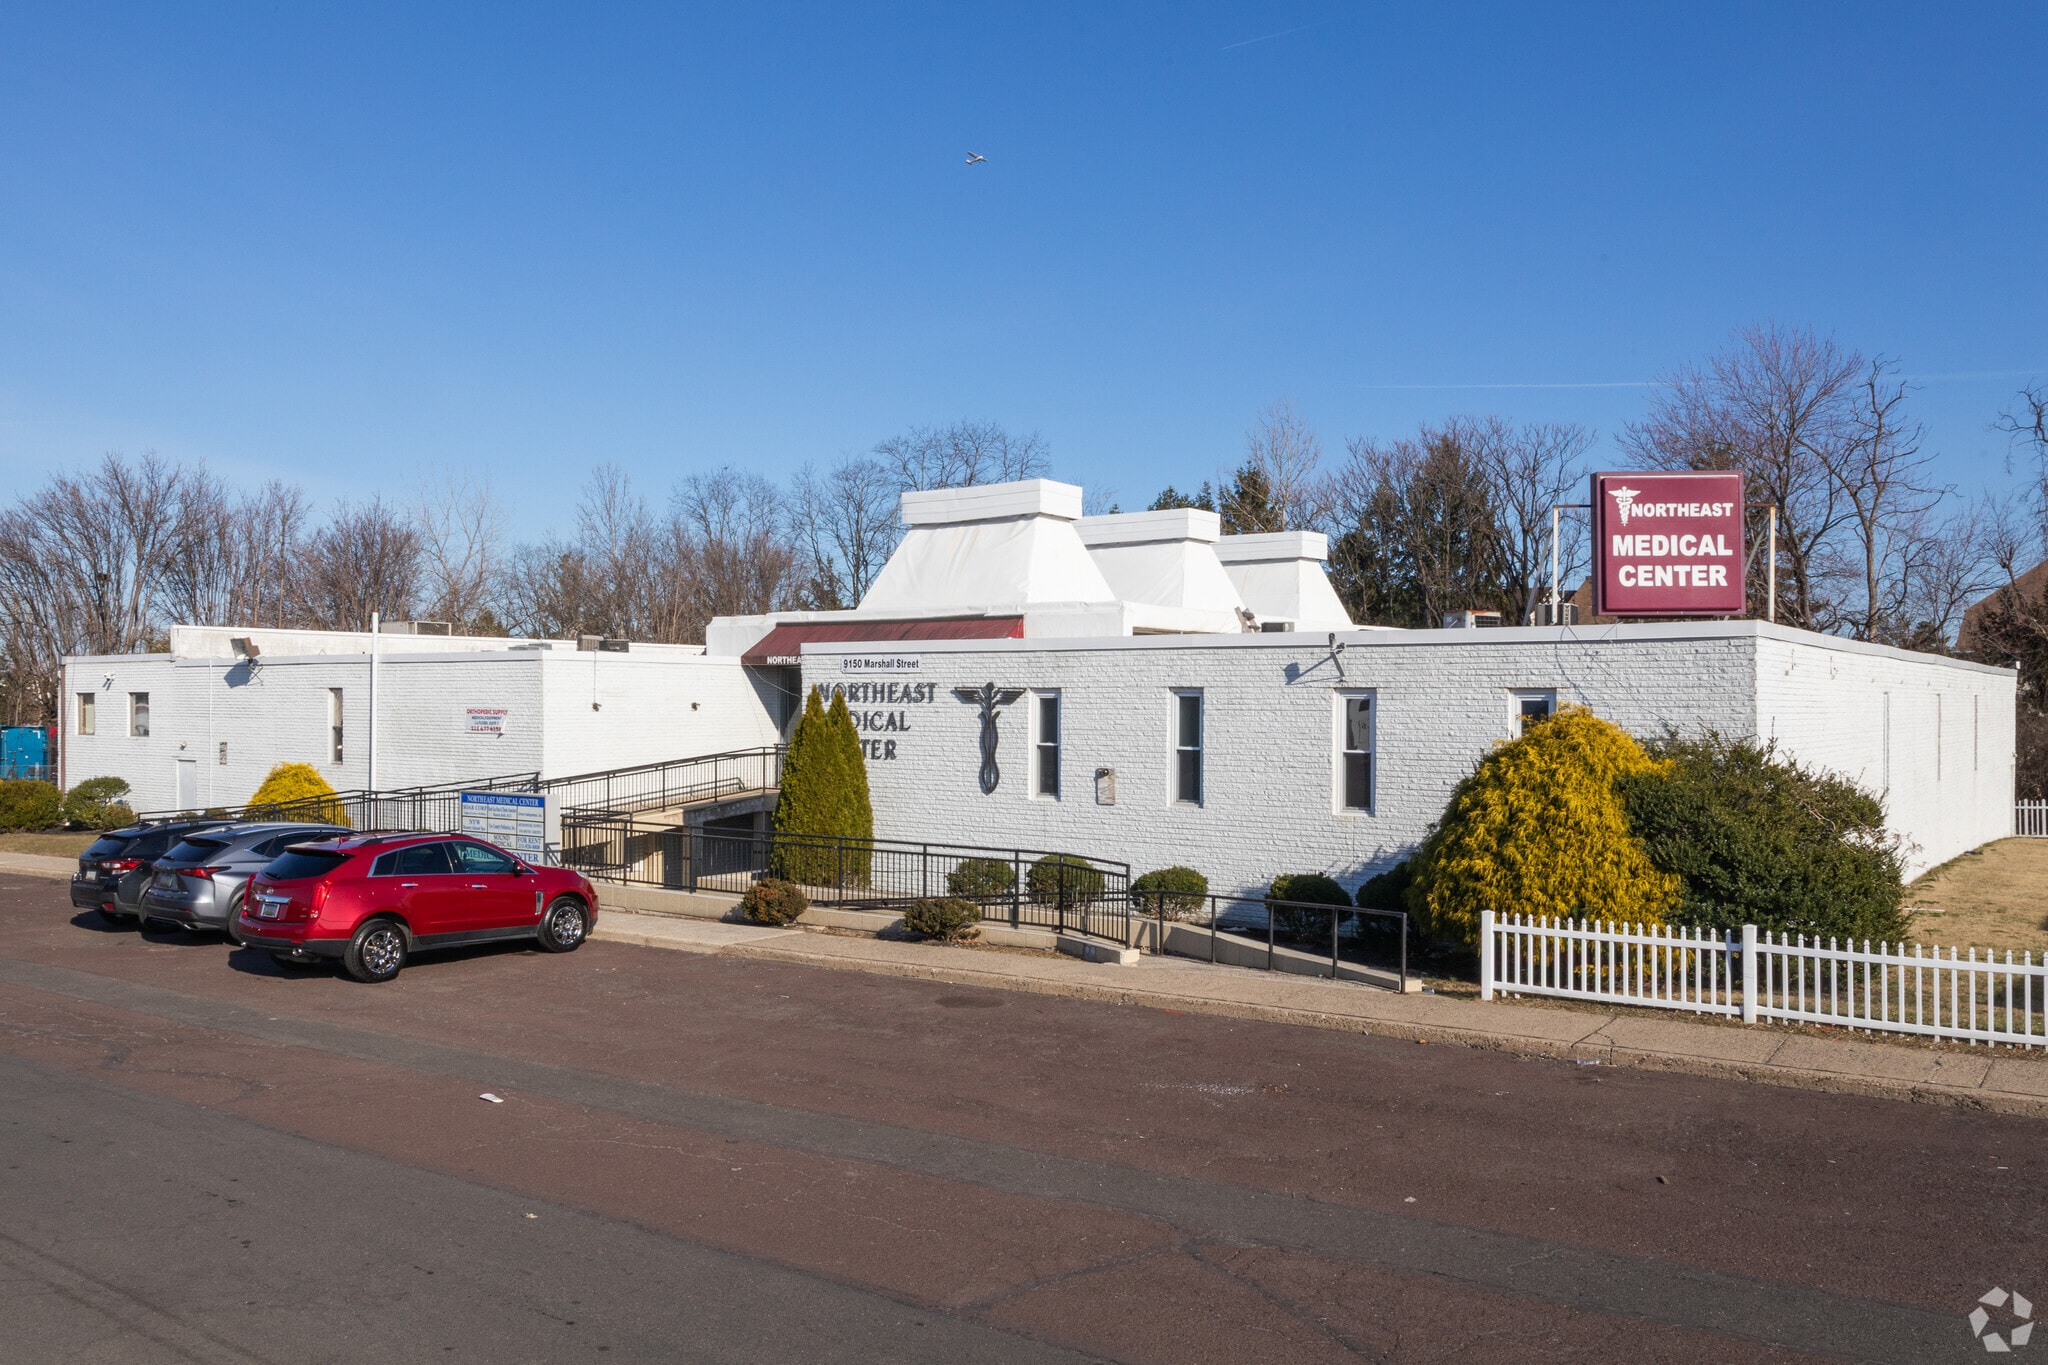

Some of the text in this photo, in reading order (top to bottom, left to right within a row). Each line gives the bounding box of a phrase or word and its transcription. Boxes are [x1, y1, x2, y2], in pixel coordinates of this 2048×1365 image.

[1631, 502, 1734, 517] NORTHEAST
[1612, 534, 1733, 556] MEDICAL
[1618, 564, 1728, 587] CENTER
[766, 655, 802, 665] NORTHEA
[843, 658, 919, 668] 9150 Marshall Street
[817, 682, 937, 704] NORTHEAST
[849, 710, 912, 731] DICAL
[860, 738, 897, 760] TER
[467, 795, 539, 807] NORTHEAST MEDICAL CENTER
